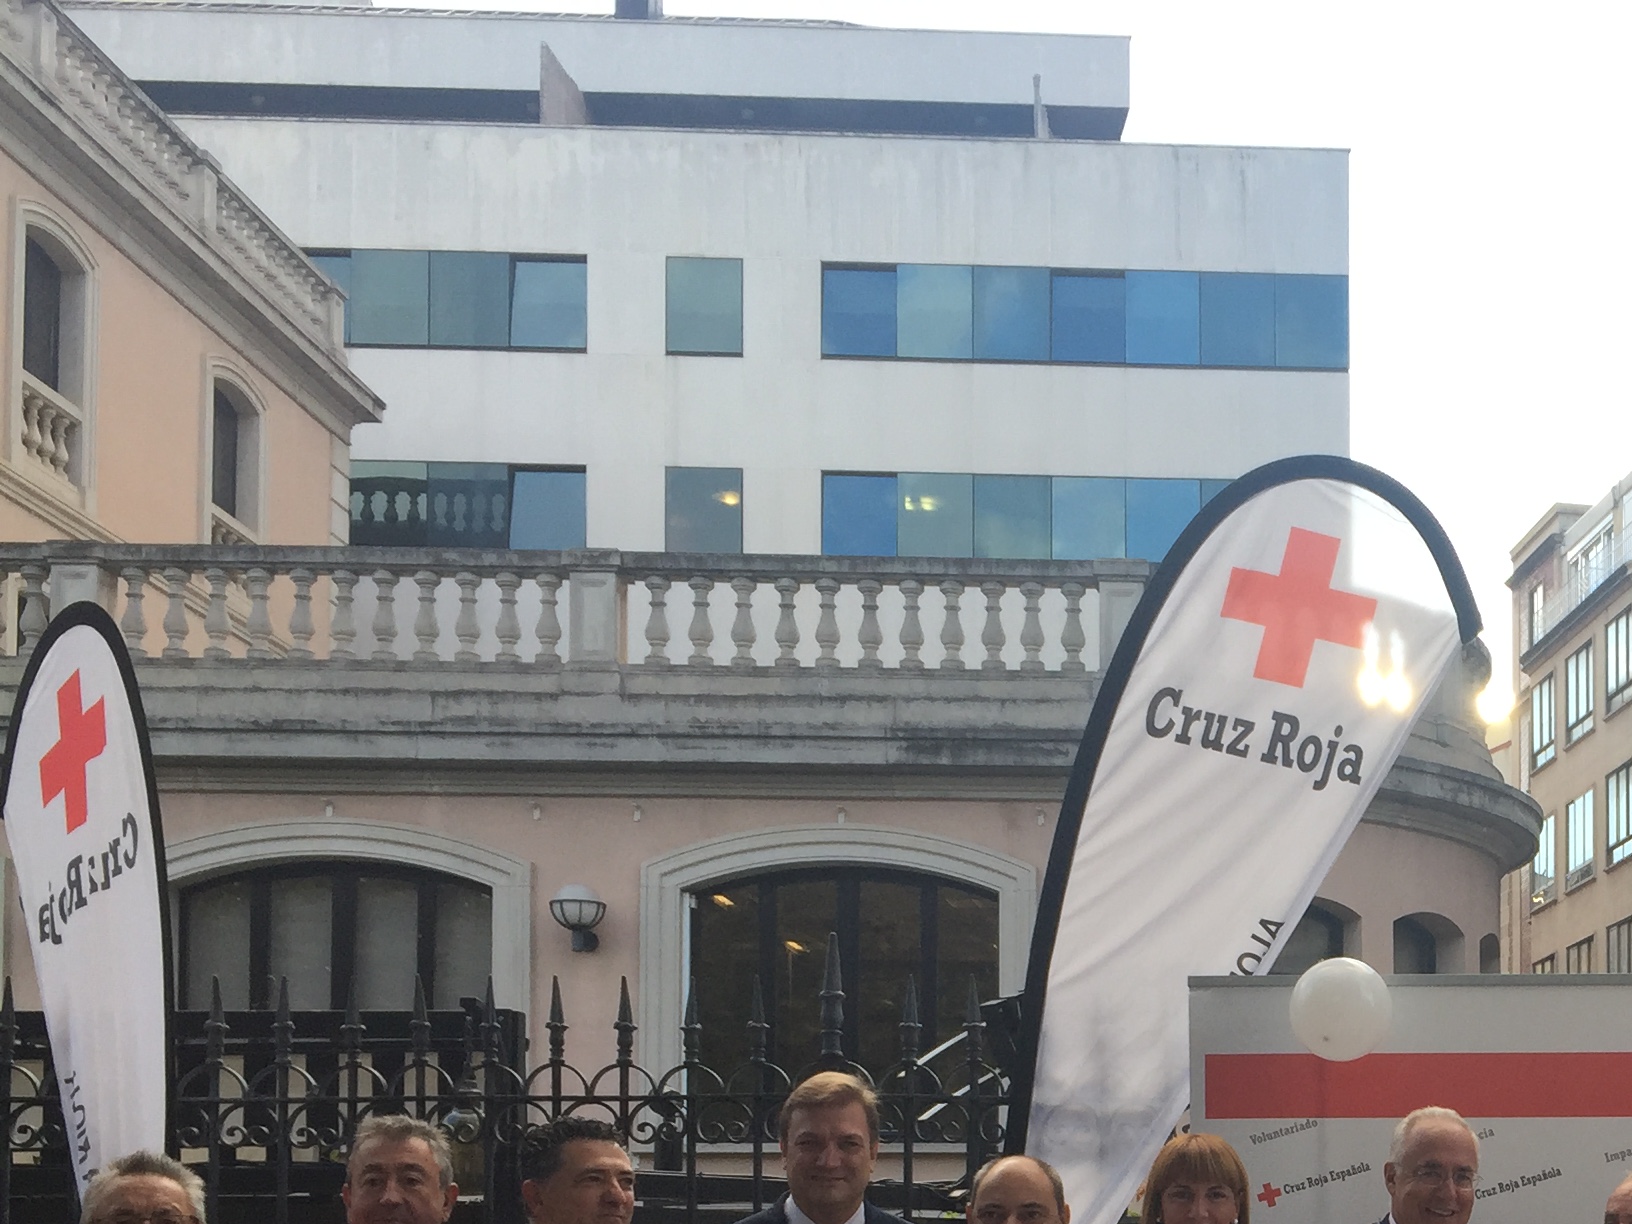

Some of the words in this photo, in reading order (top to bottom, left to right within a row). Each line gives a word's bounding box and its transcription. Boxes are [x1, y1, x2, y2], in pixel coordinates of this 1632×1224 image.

[1145, 686, 1255, 758] Cruz
[1260, 710, 1364, 791] Roja
[1249, 1119, 1319, 1145] Voluntariado
[1283, 1182, 1306, 1194] Cruz
[1307, 1174, 1329, 1188] Roja
[1329, 1162, 1371, 1182] Española
[1474, 1186, 1497, 1200] Cruz
[1498, 1180, 1520, 1193] Roja
[1520, 1167, 1562, 1187] Española
